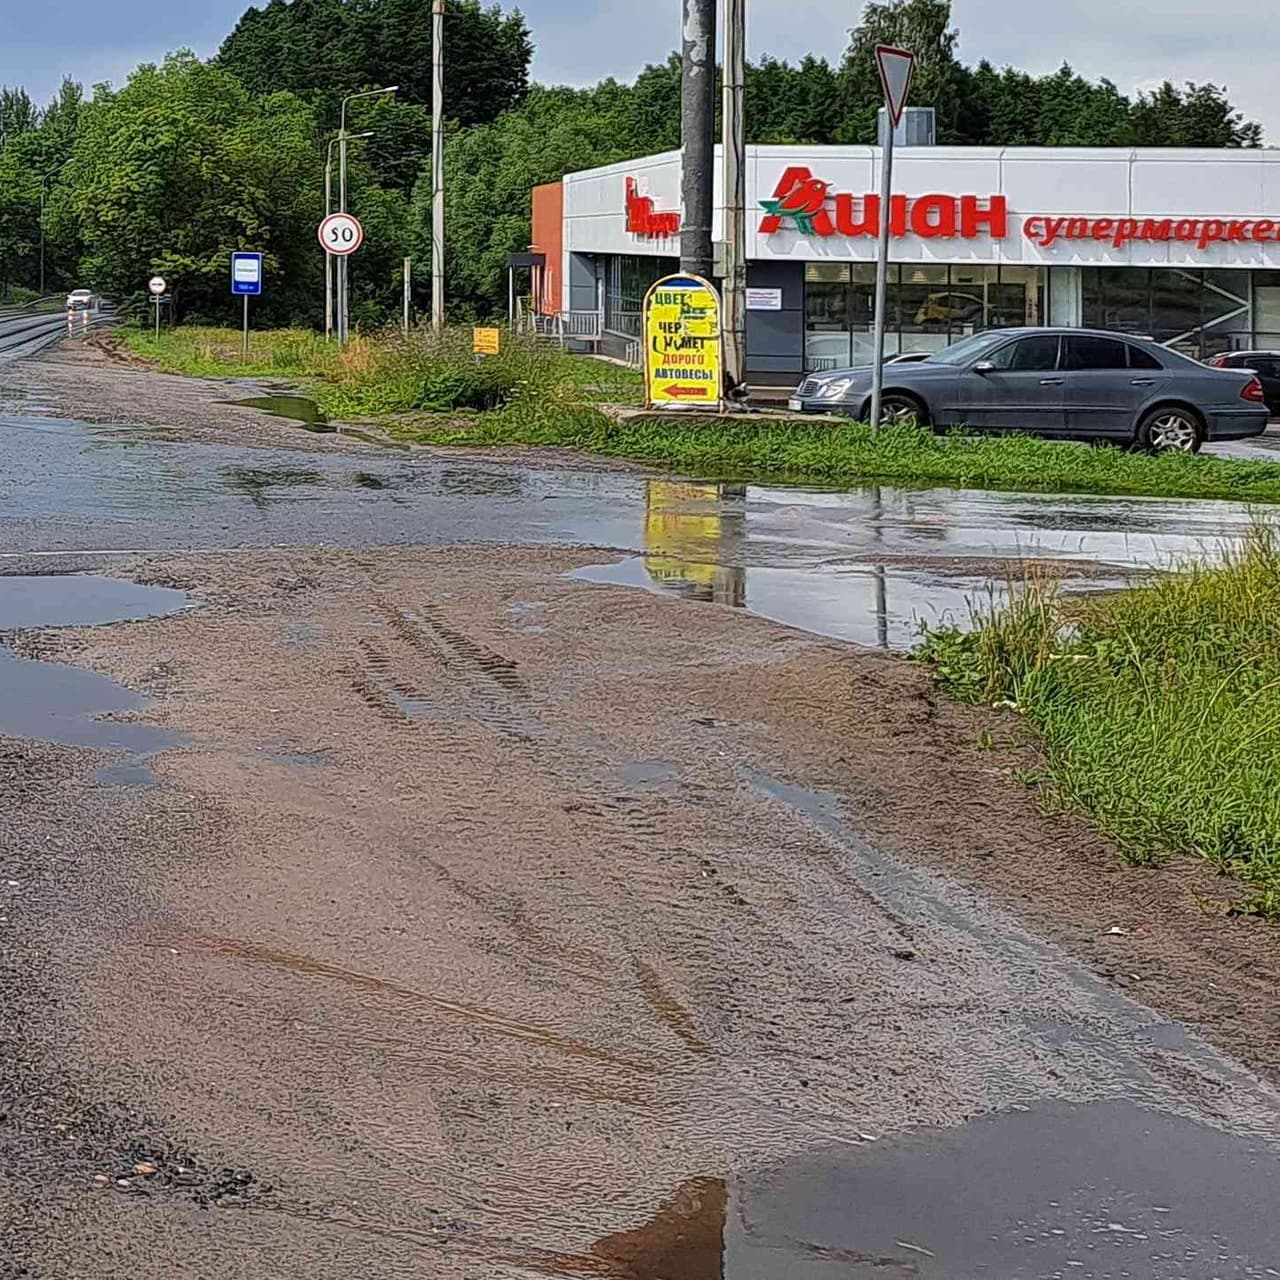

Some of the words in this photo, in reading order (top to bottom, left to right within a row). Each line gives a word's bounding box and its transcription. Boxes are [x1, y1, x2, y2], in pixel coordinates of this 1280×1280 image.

[1023, 217, 1280, 250] супермарке
[662, 354, 705, 365] ДОРОГО
[654, 368, 713, 380] АВТОВЕСЫ
